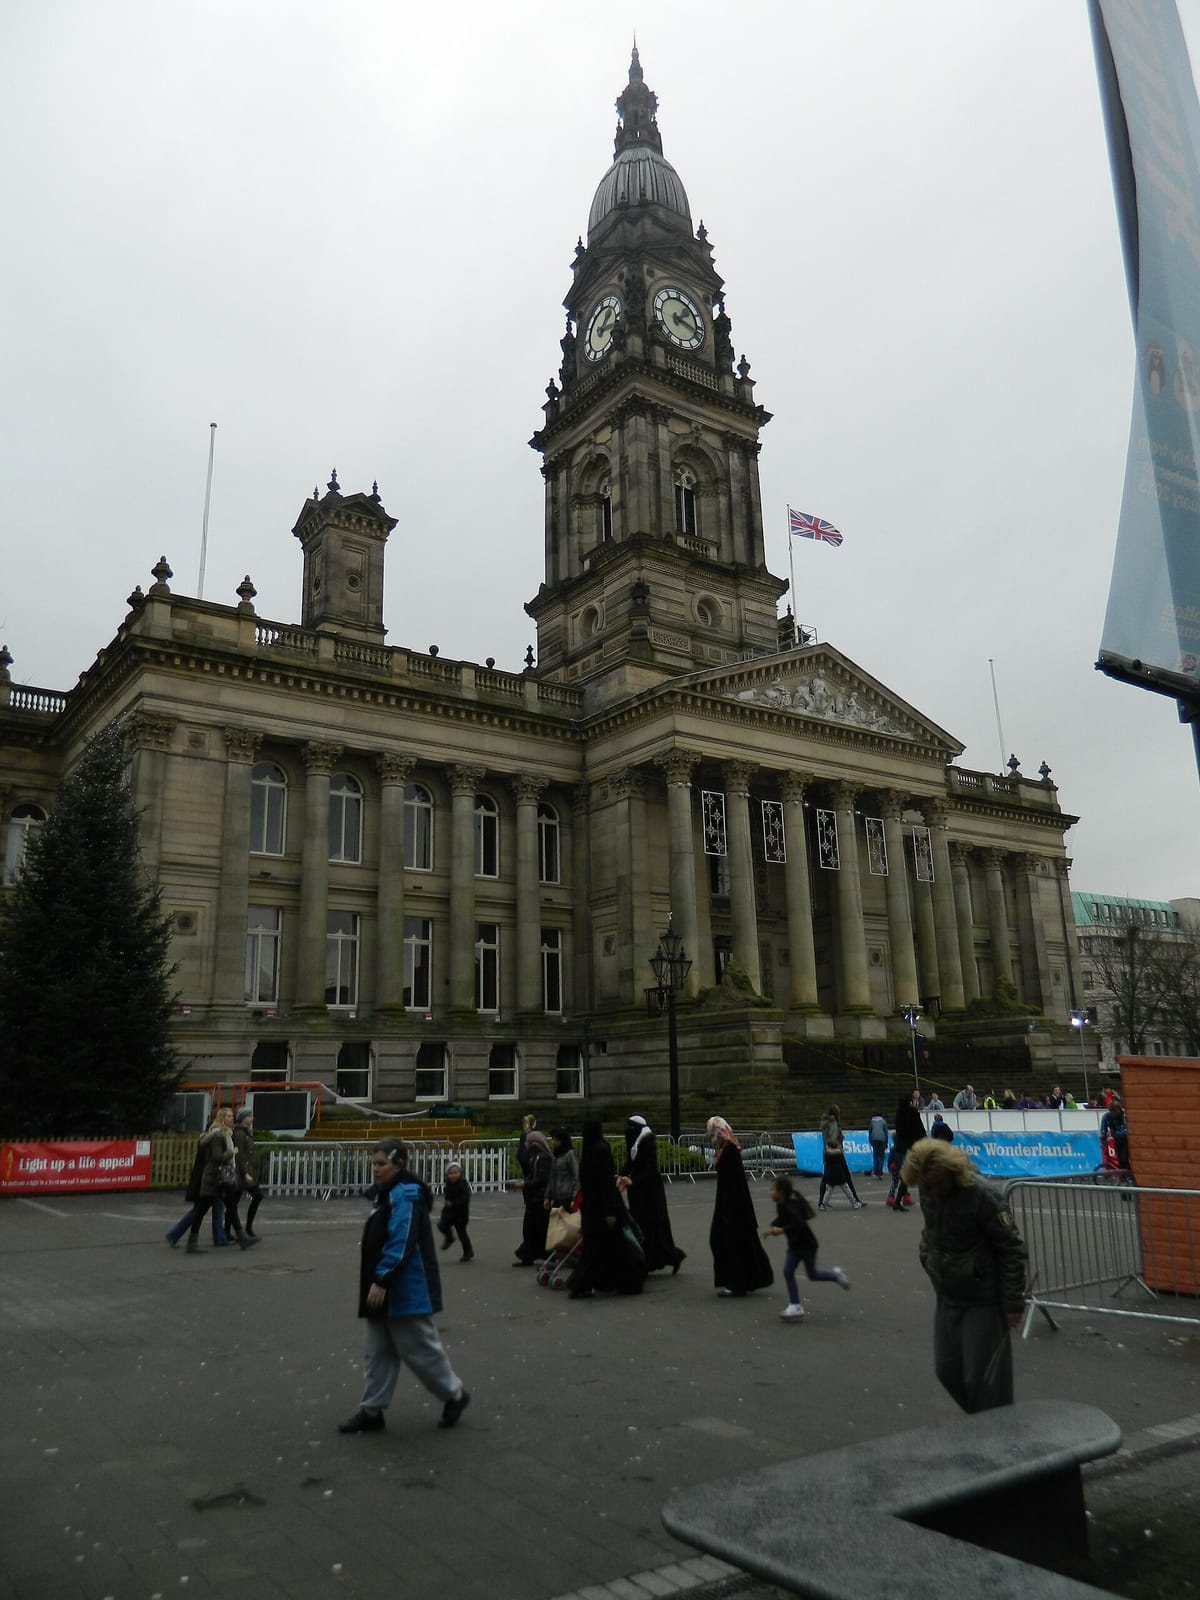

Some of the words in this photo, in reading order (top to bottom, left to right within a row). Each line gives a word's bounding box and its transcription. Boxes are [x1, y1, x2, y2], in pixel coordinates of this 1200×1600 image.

[842, 1140, 873, 1153] Ska
[958, 1141, 981, 1156] ter
[982, 1141, 1086, 1157] Wonderland...
[19, 1157, 47, 1174] Light
[51, 1159, 65, 1172] up
[68, 1160, 75, 1169] a
[78, 1155, 96, 1169] life
[99, 1155, 134, 1170] appeal
